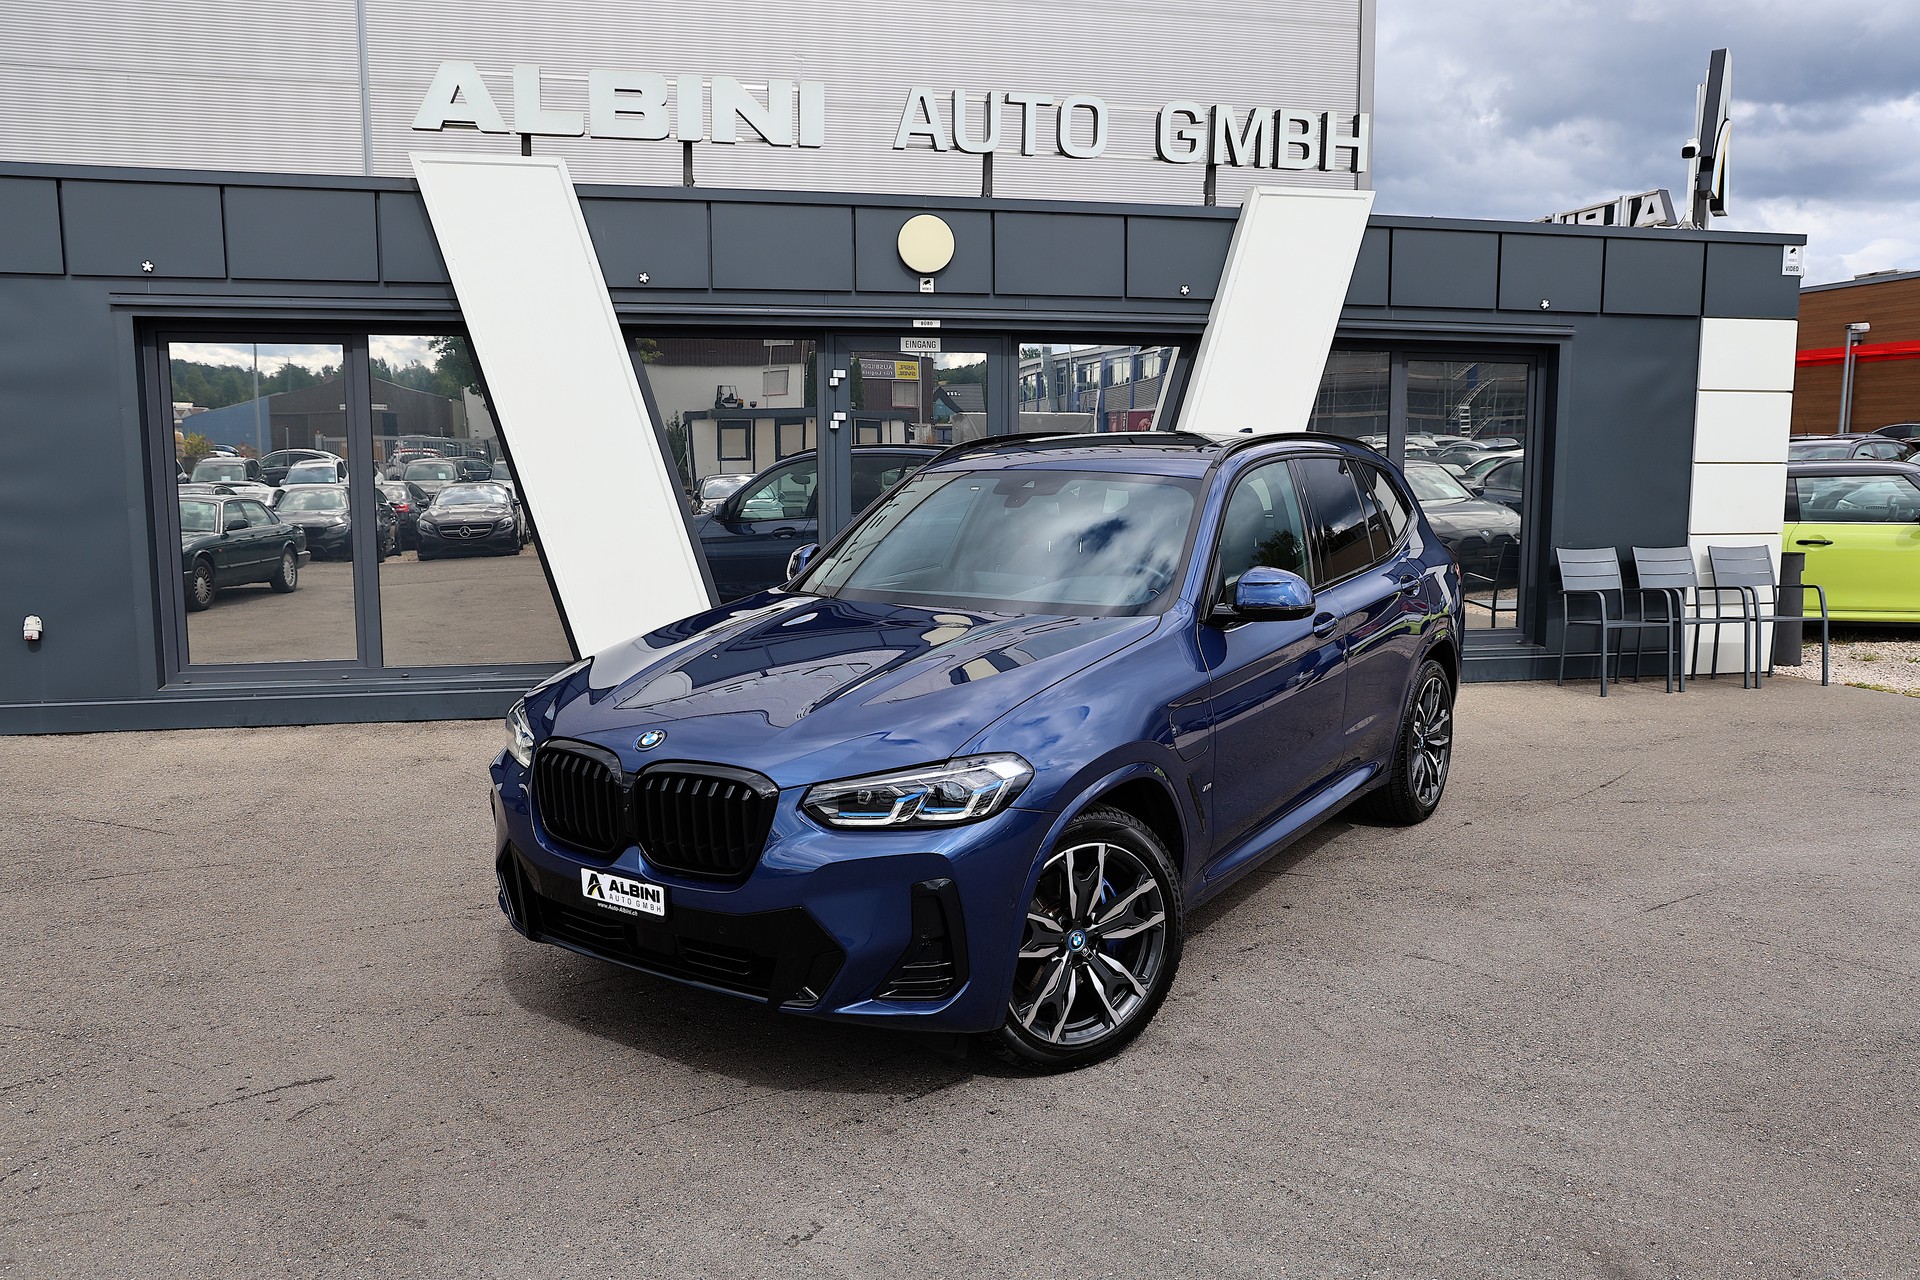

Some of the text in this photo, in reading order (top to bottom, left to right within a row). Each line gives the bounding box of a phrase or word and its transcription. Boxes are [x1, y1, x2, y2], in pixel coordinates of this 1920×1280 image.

[411, 60, 1370, 173] ALBINI AUTO GMBH
[905, 340, 937, 349] EINGANG
[609, 879, 661, 903] ALBINI
[597, 902, 638, 916] www.Auto-Albini.ch
[609, 893, 662, 912] AUTO GMBH
